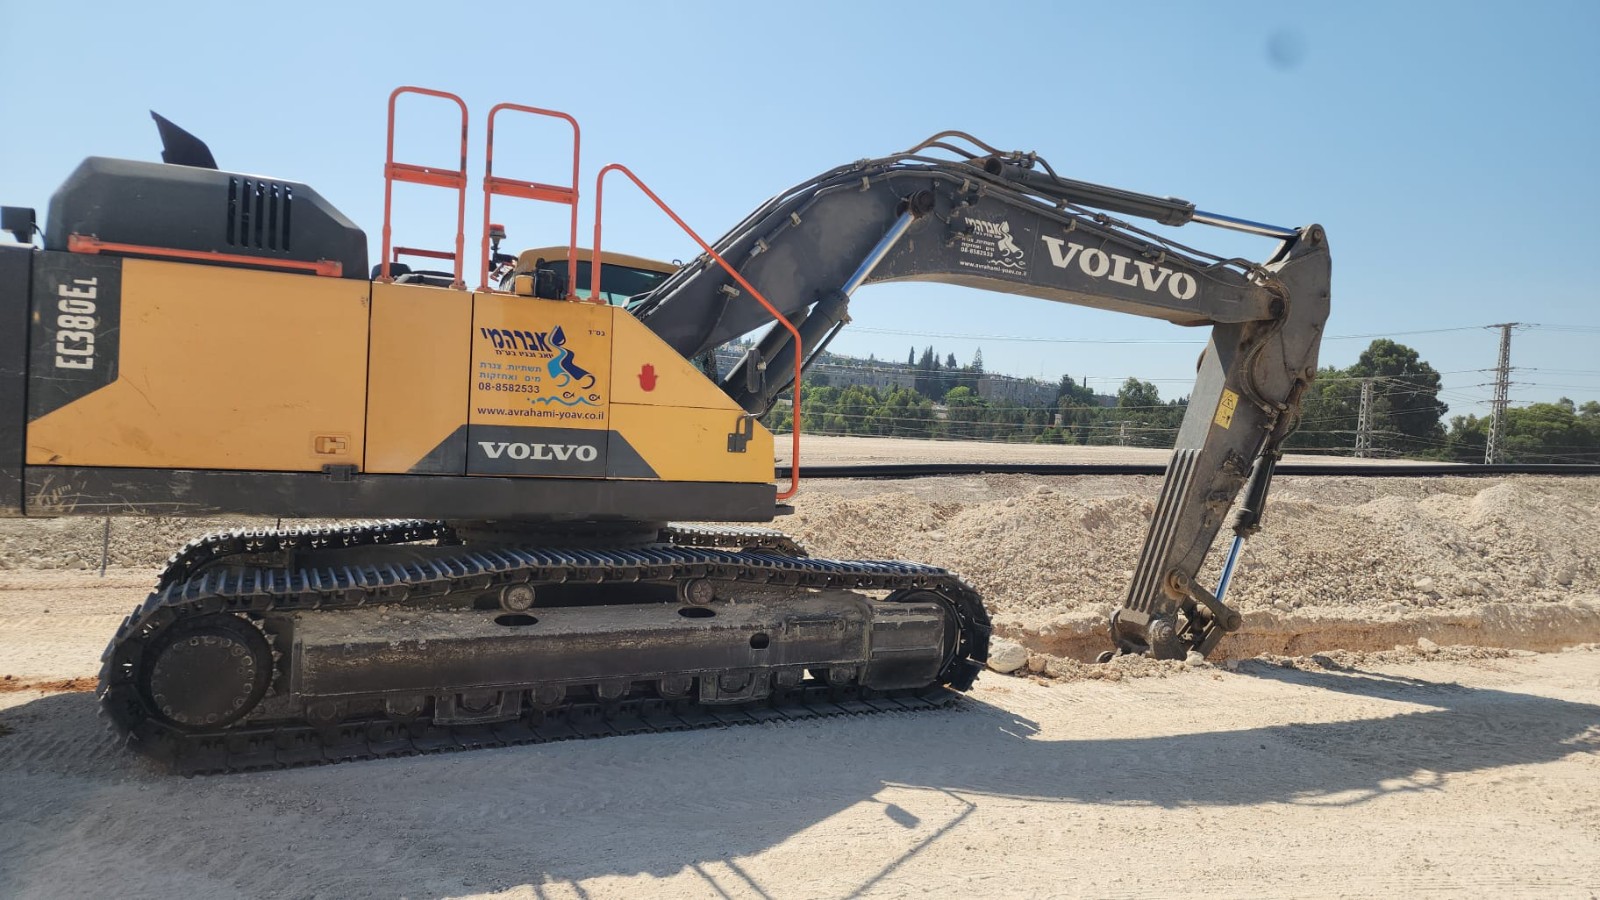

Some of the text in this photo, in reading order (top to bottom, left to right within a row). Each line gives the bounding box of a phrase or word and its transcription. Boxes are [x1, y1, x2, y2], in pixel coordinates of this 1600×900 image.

[1041, 235, 1197, 300] VOLVO
[55, 277, 98, 370] EC380EL
[480, 327, 553, 352] אברהמי
[479, 371, 518, 381] ואחזקות
[478, 381, 540, 394] 08-8582533
[477, 407, 605, 420] www.avrahami-yoav.co.il
[477, 441, 598, 462] VOLVO
